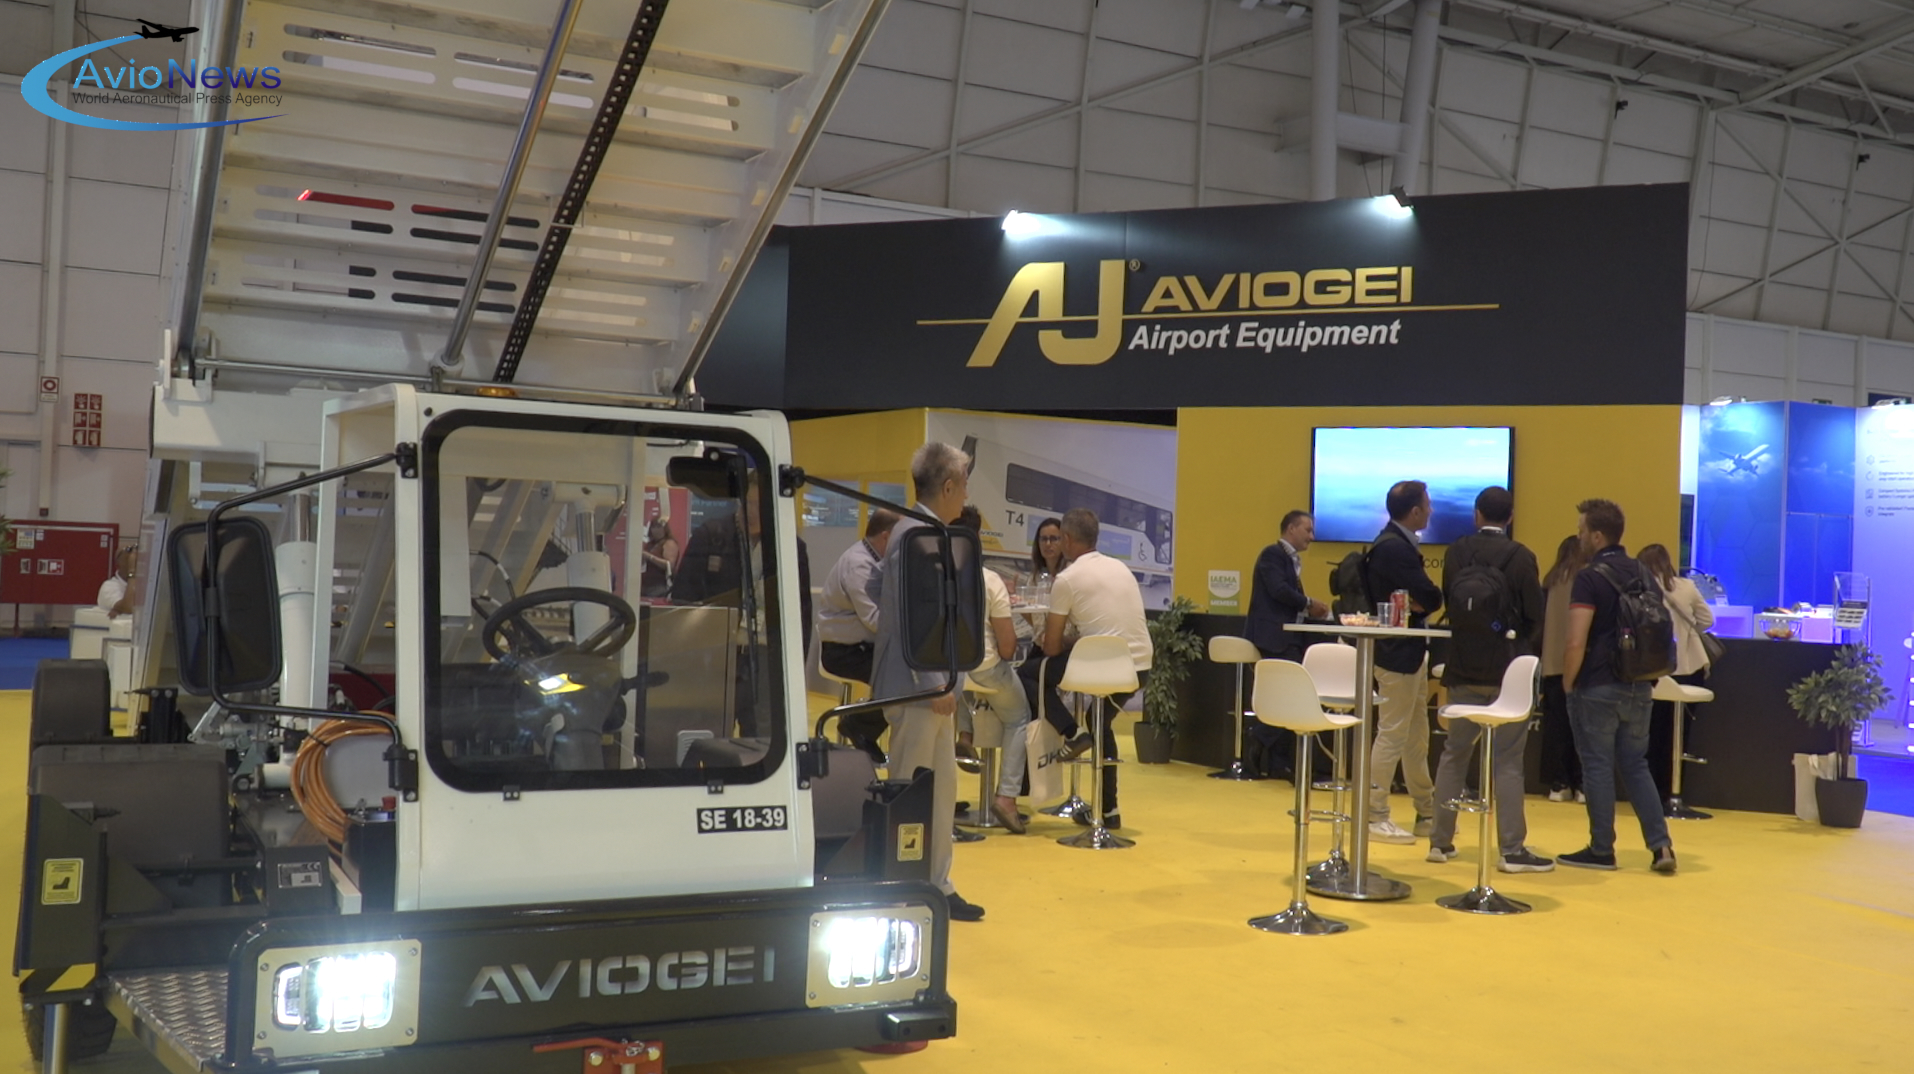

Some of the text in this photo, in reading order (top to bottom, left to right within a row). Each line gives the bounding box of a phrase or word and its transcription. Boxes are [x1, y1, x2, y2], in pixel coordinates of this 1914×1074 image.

[1141, 266, 1412, 313] AVIOGEI
[1128, 318, 1401, 355] Airport Equipment
[1006, 510, 1024, 527] T4
[700, 807, 785, 830] SE 18-39
[463, 945, 775, 1008] AVIOGEI
